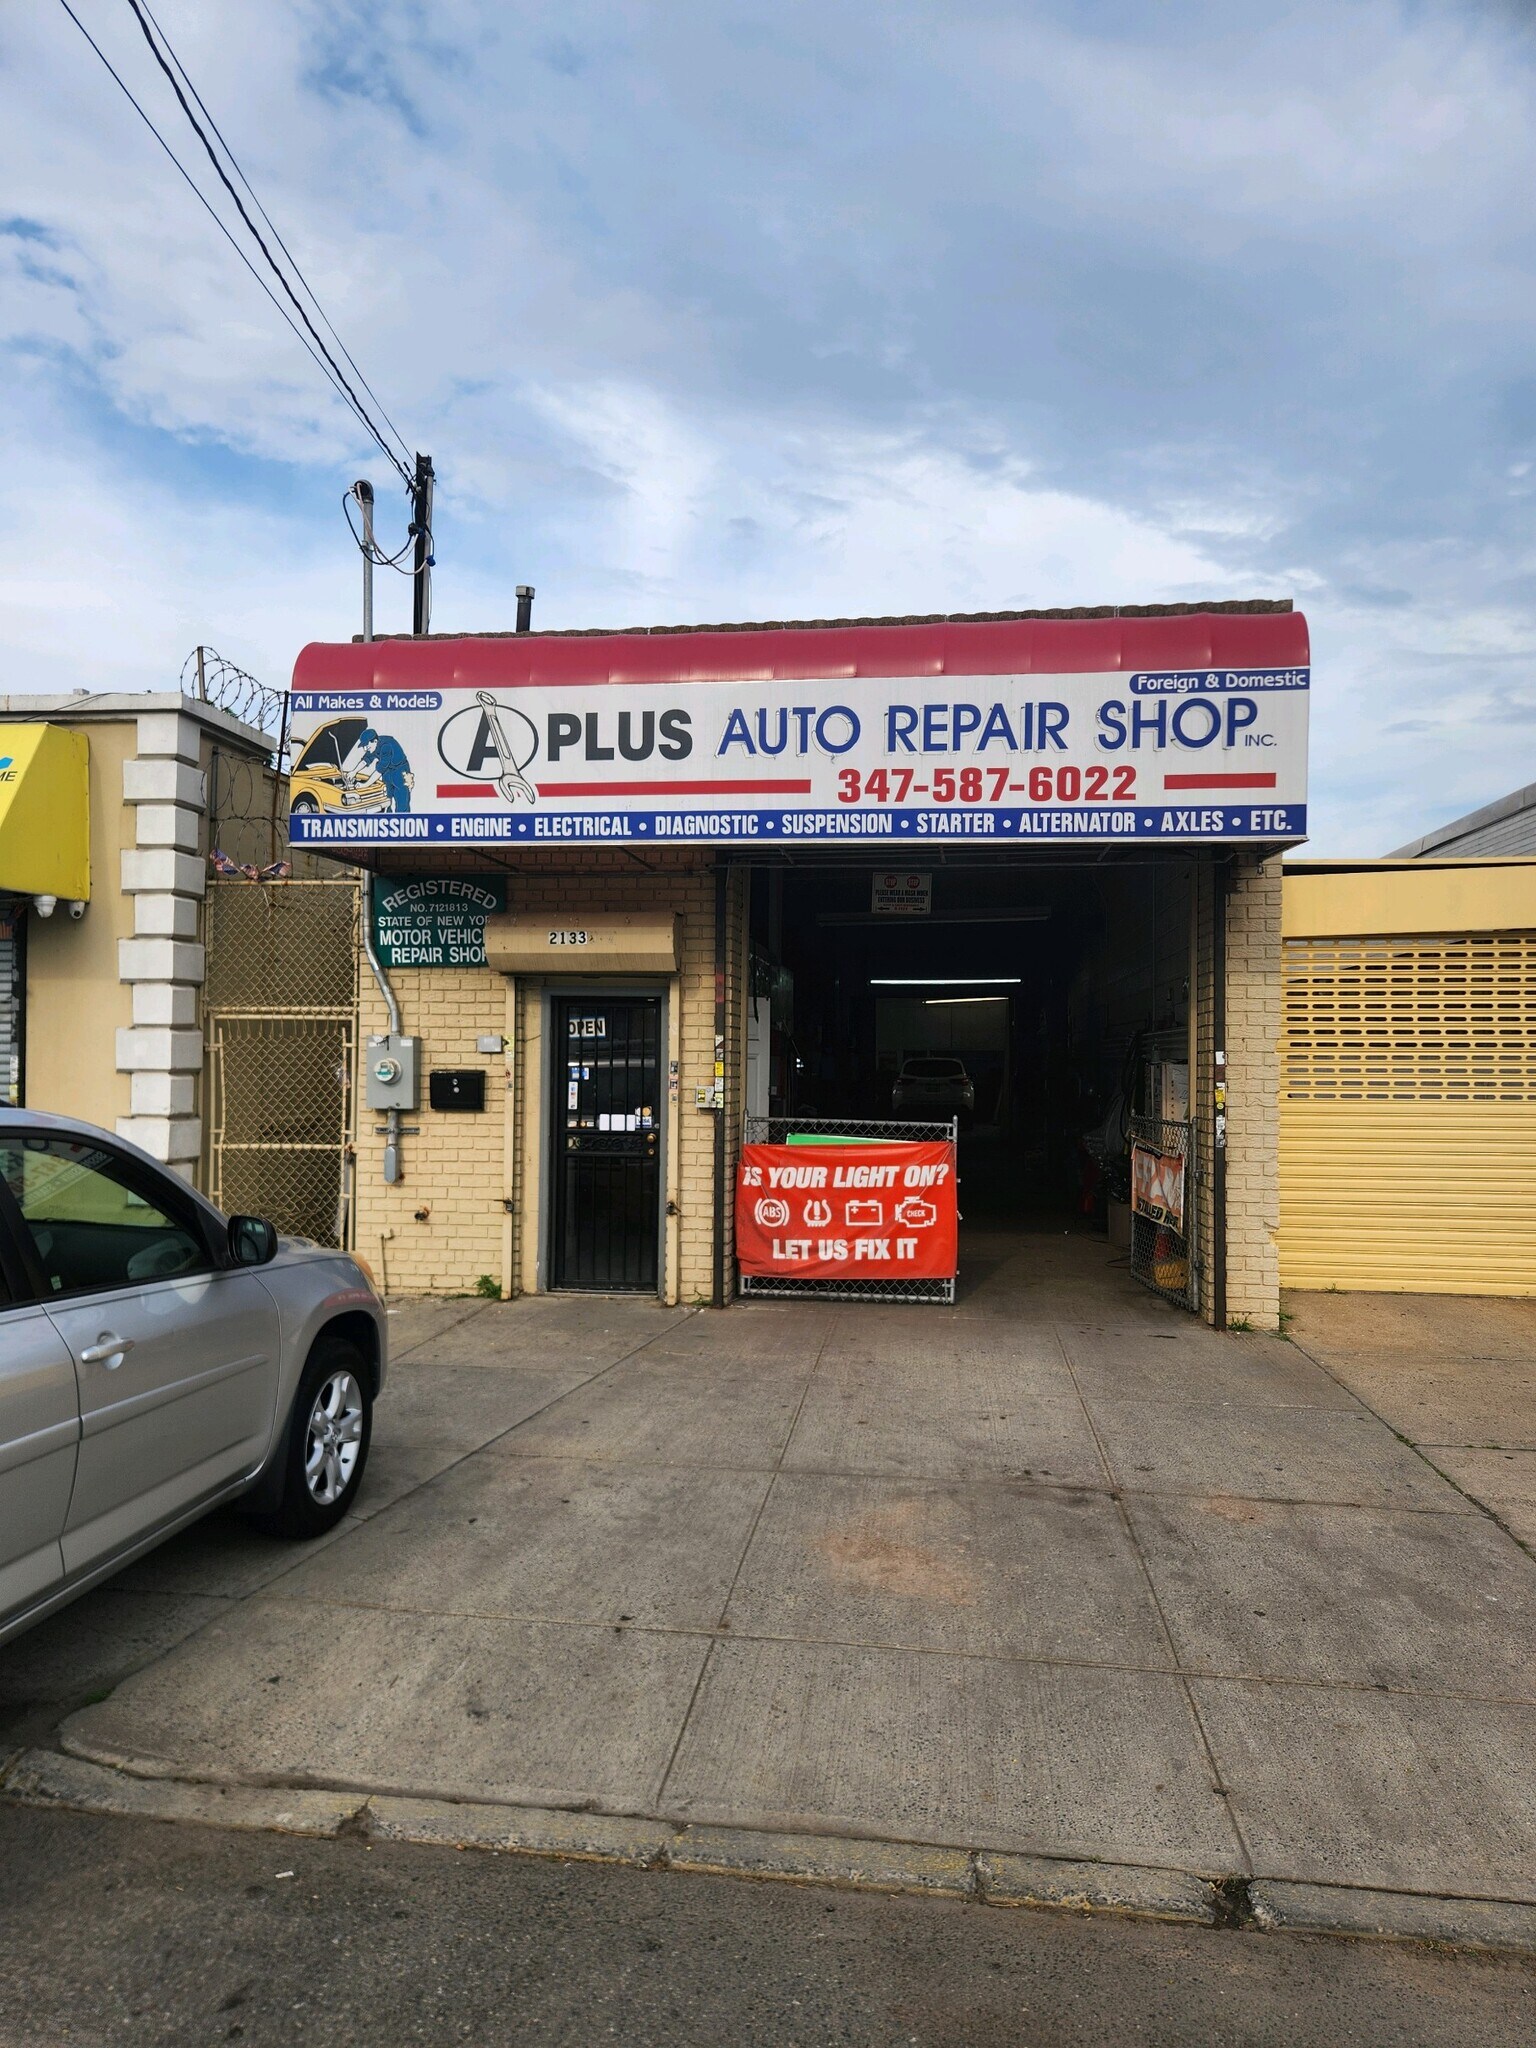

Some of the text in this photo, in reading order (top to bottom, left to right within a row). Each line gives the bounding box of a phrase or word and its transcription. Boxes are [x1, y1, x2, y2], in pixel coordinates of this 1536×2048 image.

[1138, 671, 1306, 692] Foreign & Domestic
[295, 694, 437, 708] All Makes & Models
[547, 709, 693, 762] PLUS
[718, 705, 862, 755] AUTO
[886, 701, 1070, 752] REPAIR
[1099, 697, 1257, 750] SHOP
[1245, 733, 1278, 748] INC.
[837, 766, 1138, 803] 347-587-6022
[302, 809, 1292, 838] TRANSMISSION ENGINE ELECTRICAL DIAGNOSTIC SUSPENSION STARTER ALTERNATOR AXLES ETC.
[382, 880, 497, 912] REGISTERED
[378, 916, 412, 927] STATE
[417, 916, 432, 926] OF
[437, 916, 463, 926] NEW
[380, 928, 485, 945] MOTOR VEHIC
[549, 931, 586, 945] 2133
[392, 947, 442, 963] REPAIR
[569, 1020, 603, 1035] OPEN
[743, 1163, 949, 1188] IS YOUR LIGHT ON?
[763, 1207, 926, 1218] ABS CHECK
[773, 1238, 918, 1260] LET US FIX IT
